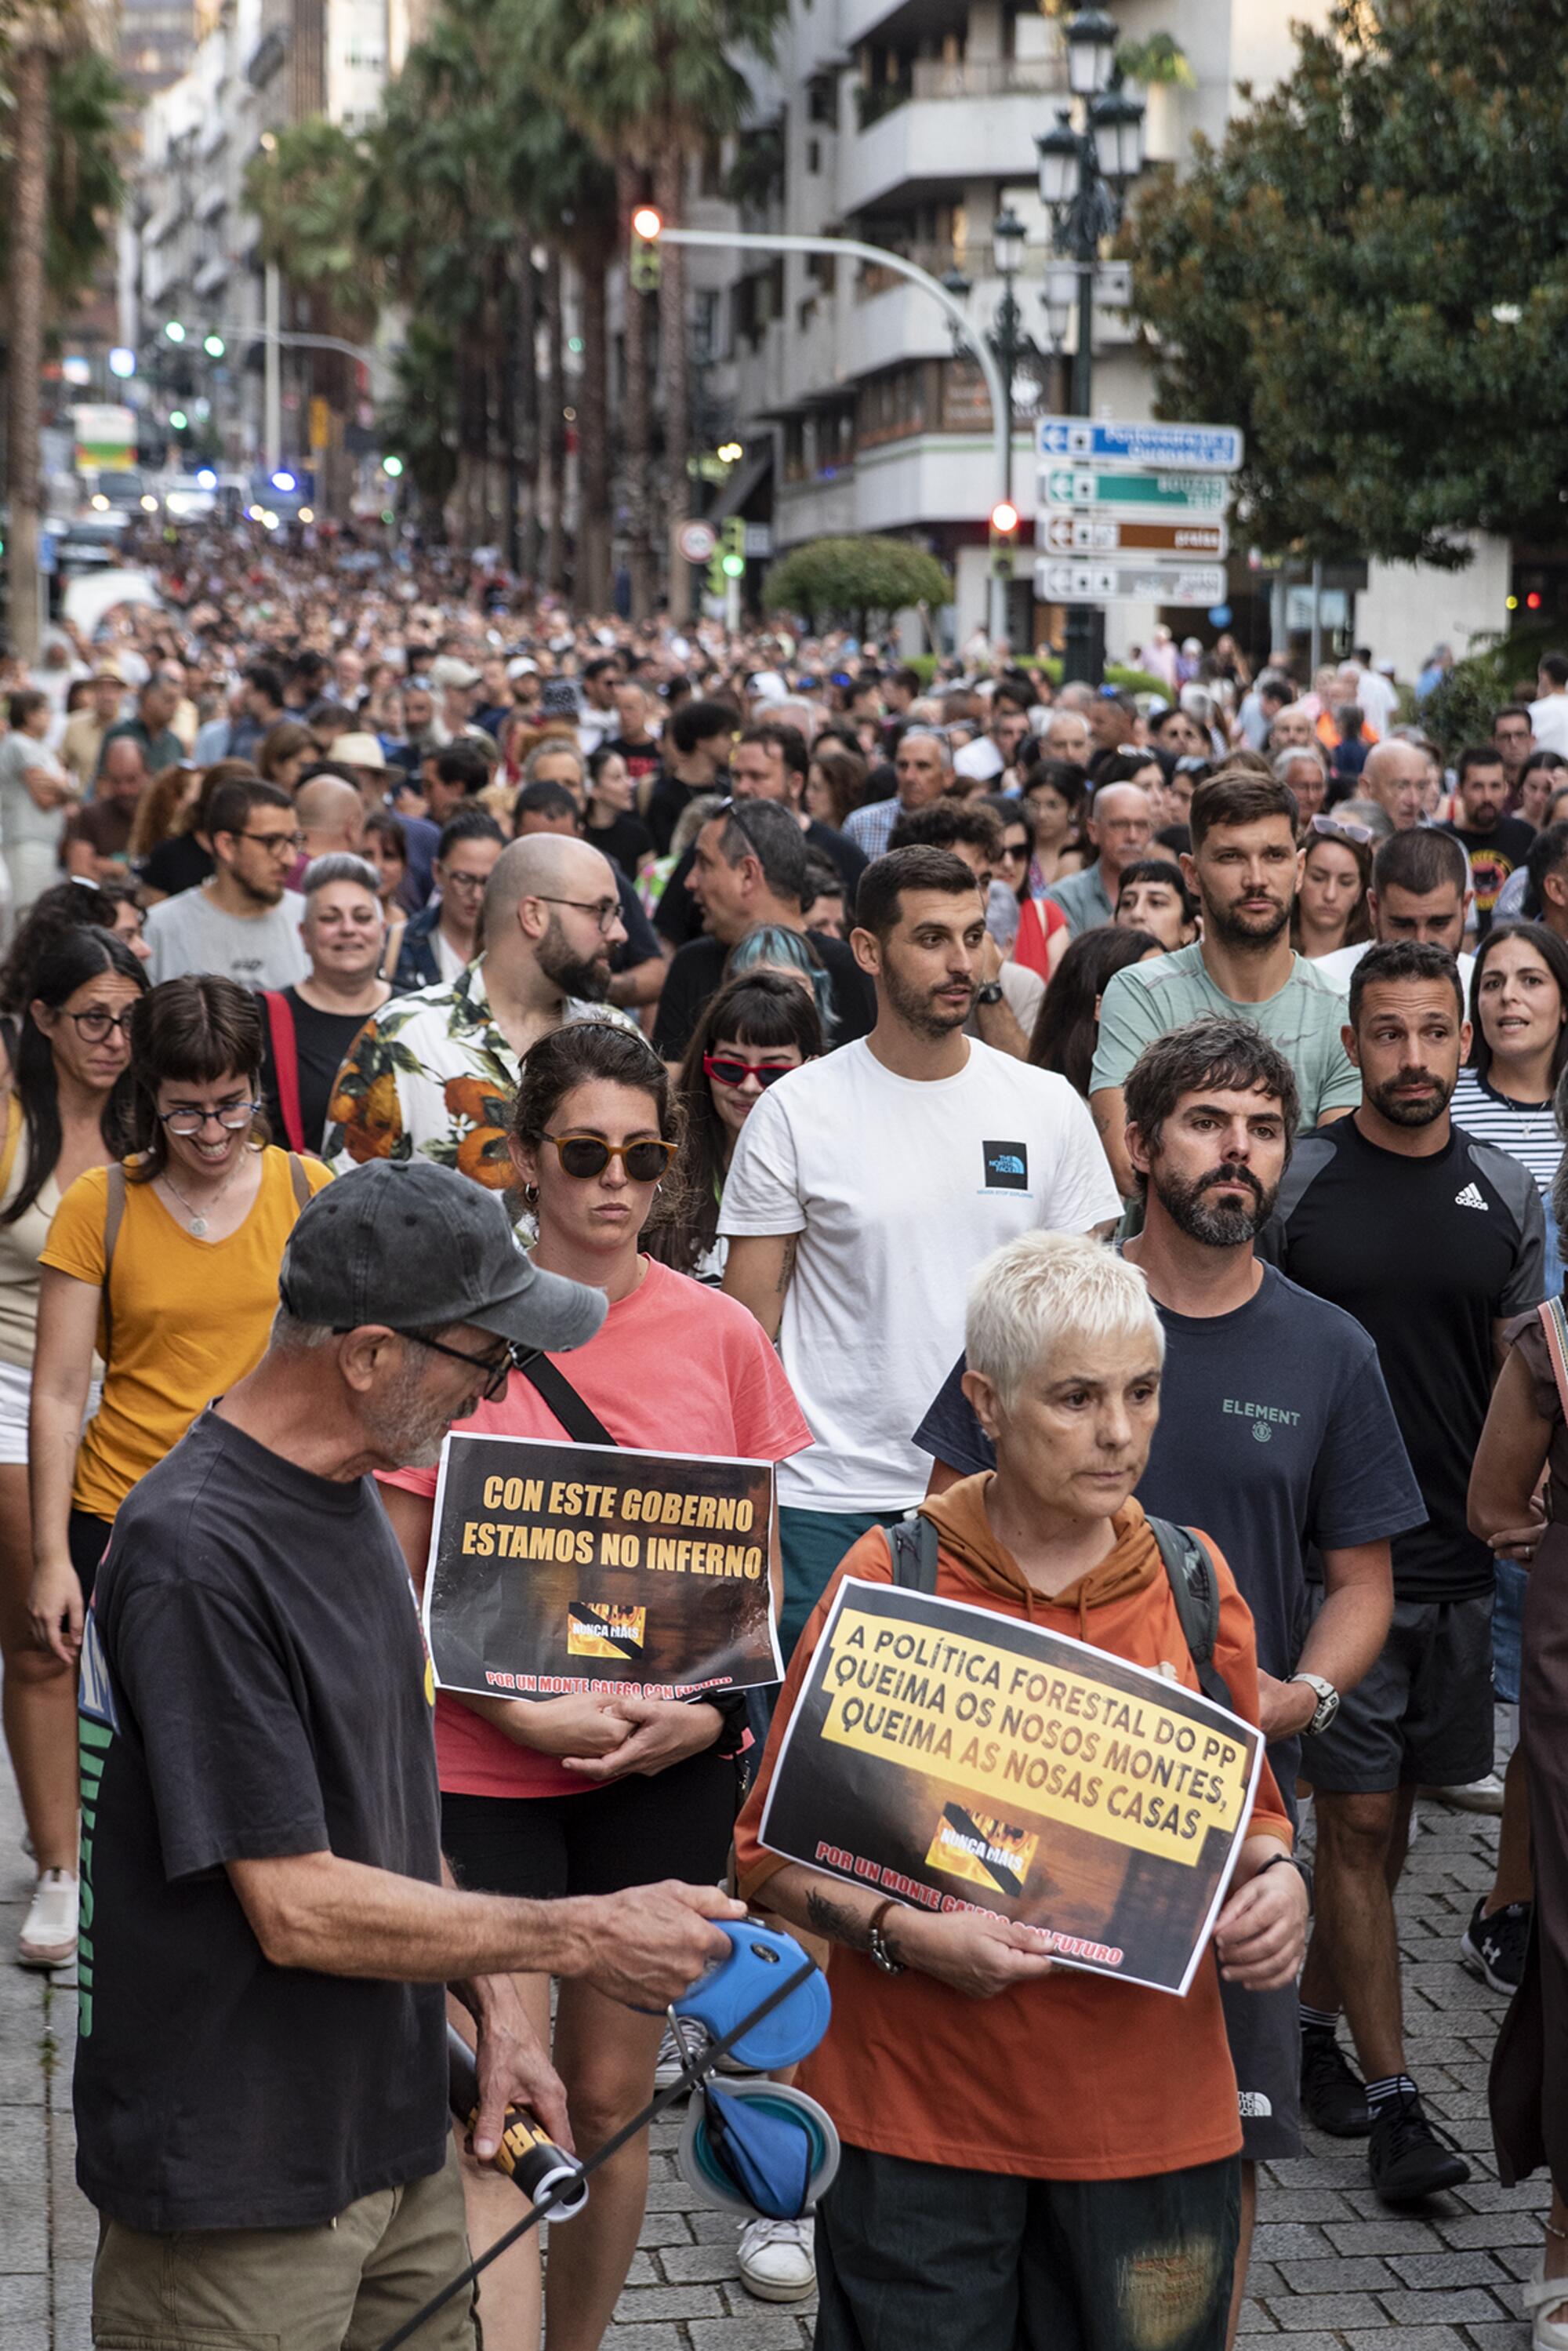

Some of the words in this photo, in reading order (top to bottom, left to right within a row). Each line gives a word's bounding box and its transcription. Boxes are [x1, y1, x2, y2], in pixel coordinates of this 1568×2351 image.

[1455, 1196, 1489, 1211] adidas
[1222, 1398, 1301, 1426] ELEMENT
[484, 1475, 544, 1512] CON
[548, 1481, 618, 1518] ESTE
[621, 1489, 753, 1532] GOBERNO
[462, 1522, 594, 1564] ESTAMOS
[601, 1533, 640, 1568] NO
[646, 1538, 763, 1579] INFERNO
[572, 1622, 609, 1637] NUNCA
[610, 1626, 640, 1638] MAIS
[485, 1671, 514, 1689] POR
[516, 1673, 536, 1691] UN
[539, 1675, 590, 1695] MONTE
[846, 1625, 866, 1649] A
[874, 1629, 1001, 1690] POLÍTICA
[1008, 1668, 1146, 1739] FORESTAL
[1153, 1717, 1196, 1754] DO
[1203, 1737, 1237, 1768] PP
[834, 1655, 947, 1714] QUEIMA
[955, 1691, 996, 1728] OS
[1000, 1706, 1098, 1763] NOSOS
[1105, 1739, 1229, 1814] MONTES,
[840, 1697, 952, 1760] QUEIMA
[959, 1735, 997, 1773] AS
[1003, 1750, 1103, 1808] NOSAS
[1107, 1785, 1200, 1842] CASAS
[815, 1840, 854, 1872] POR
[854, 1855, 881, 1882] UN
[880, 1867, 942, 1910] MONTE
[939, 1827, 987, 1859] NUNCA
[985, 1844, 1024, 1873] MAIS
[1051, 1931, 1124, 1966] FUTURO
